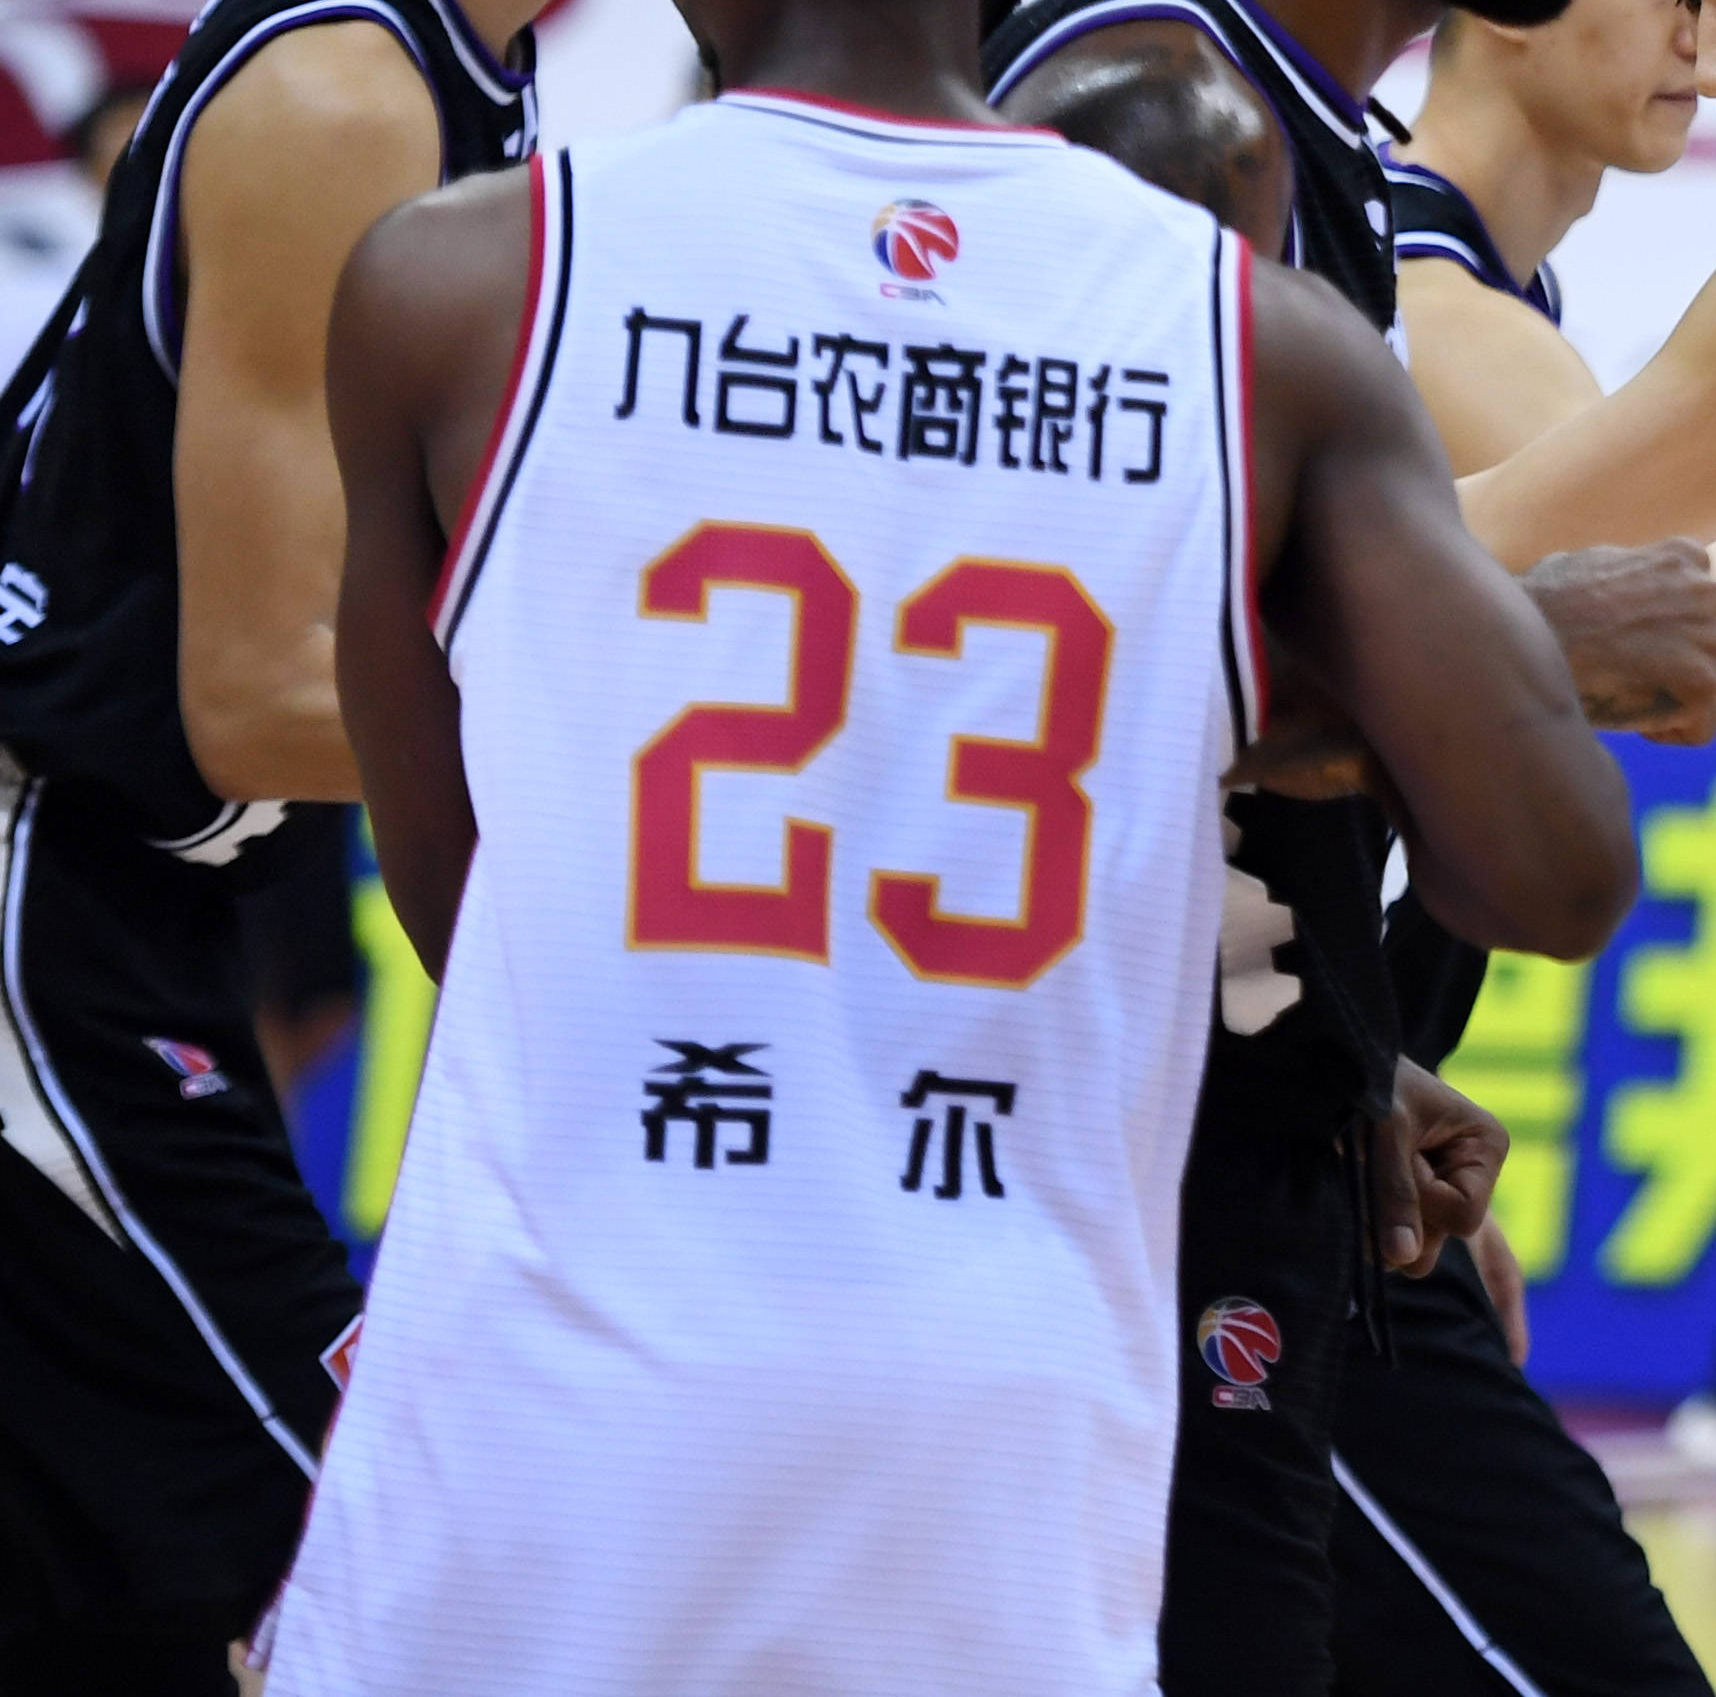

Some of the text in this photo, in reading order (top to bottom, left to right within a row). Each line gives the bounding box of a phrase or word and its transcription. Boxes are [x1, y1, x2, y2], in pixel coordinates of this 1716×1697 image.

[613, 306, 1170, 484] 九台农商银行
[625, 518, 1116, 990] 23
[640, 1038, 1018, 1200] 希尔
